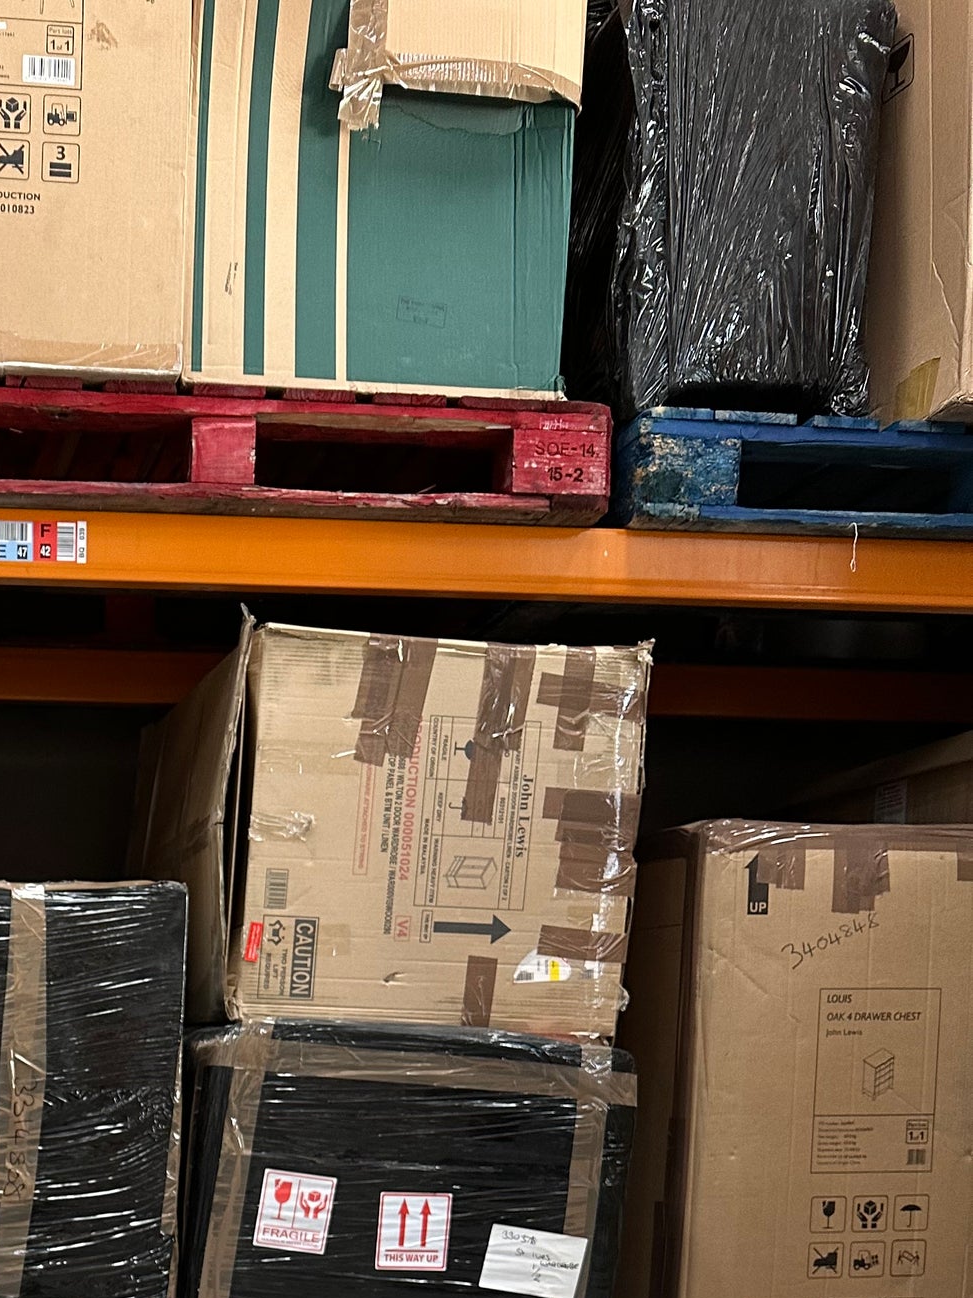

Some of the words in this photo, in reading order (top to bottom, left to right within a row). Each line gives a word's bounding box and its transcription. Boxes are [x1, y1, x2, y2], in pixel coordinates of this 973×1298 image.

[56, 145, 66, 160] 3
[547, 466, 584, 482] 15-2
[40, 523, 51, 537] F
[17, 544, 28, 559] 47
[40, 544, 51, 558] 42
[431, 747, 436, 755] OF
[405, 715, 423, 808] DUCTION
[385, 769, 395, 790] PANEL
[395, 775, 404, 800] WILTON
[520, 774, 534, 810] John
[384, 798, 392, 812] BTM
[382, 814, 390, 828] UNIT
[393, 807, 402, 825] DOOR
[381, 833, 389, 852] LINEN
[515, 816, 530, 858] Lewis
[389, 827, 400, 865] WARDROBE
[398, 812, 414, 880] 000051024
[420, 844, 428, 875] MALAYSIA
[749, 901, 767, 913] UP
[397, 920, 409, 938] V4
[292, 923, 314, 994] CAUTION
[264, 953, 272, 989] REQUIRED
[279, 966, 287, 996] PERSON
[827, 993, 852, 1003] LOUIS
[827, 1012, 845, 1021] OAK
[854, 1012, 892, 1021] DRAWER
[893, 1011, 922, 1021] CHEST
[826, 1029, 842, 1037] John
[262, 1226, 321, 1243] FRAGILE
[384, 1253, 404, 1262] THIS
[405, 1254, 425, 1262] WAY
[426, 1254, 439, 1263] UP
